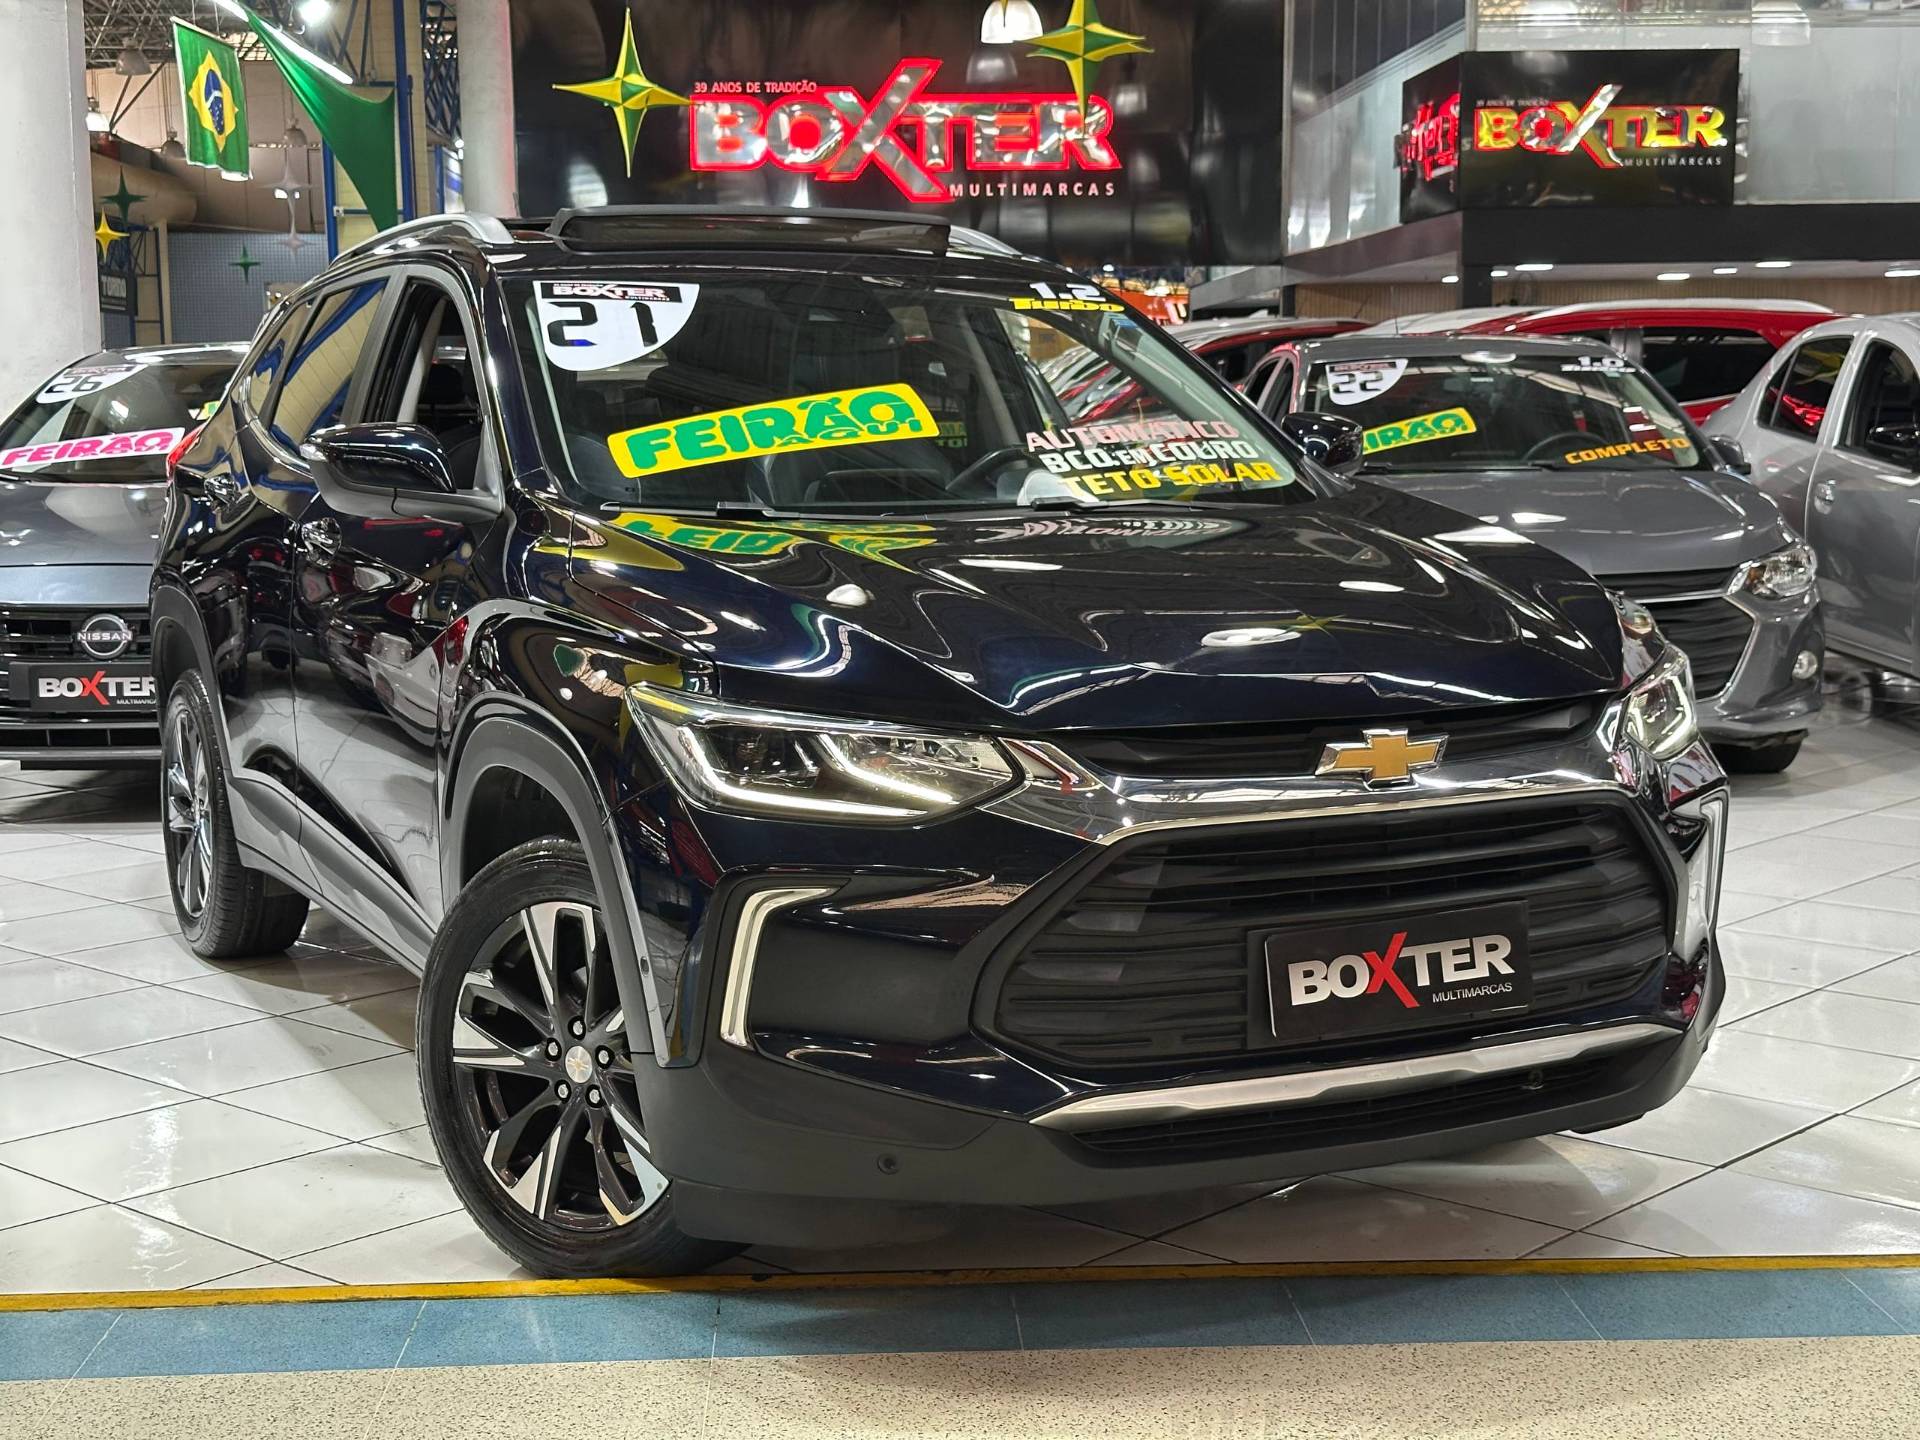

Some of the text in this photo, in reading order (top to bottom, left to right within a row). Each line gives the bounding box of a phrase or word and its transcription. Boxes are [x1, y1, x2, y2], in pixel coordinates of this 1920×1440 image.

[694, 79, 817, 94] 39 ANOS DE TRADIÇÃO
[690, 57, 1122, 203] BOXTER
[1474, 83, 1728, 168] BOXTER
[1624, 157, 1722, 167] MULTIMARCAS
[949, 183, 1116, 197] MULTIMARCAS
[553, 284, 667, 299] BOXTER
[1030, 282, 1106, 302] 1.2
[1009, 298, 1125, 312] Turbo
[547, 301, 658, 348] 21
[45, 375, 103, 393] 26
[1332, 370, 1384, 393] 22
[625, 391, 916, 469] FEIRÃO
[1365, 412, 1468, 450] IRÃO
[2, 431, 174, 466] FEIRÃO
[1564, 438, 1692, 465] COMPLETO
[1059, 461, 1283, 497] TETO SOLAR
[77, 632, 132, 641] NISSAN
[38, 670, 156, 706] BOXTER
[1287, 931, 1515, 1009] BOXTER
[1432, 982, 1513, 1003] MULTIMARCAS
